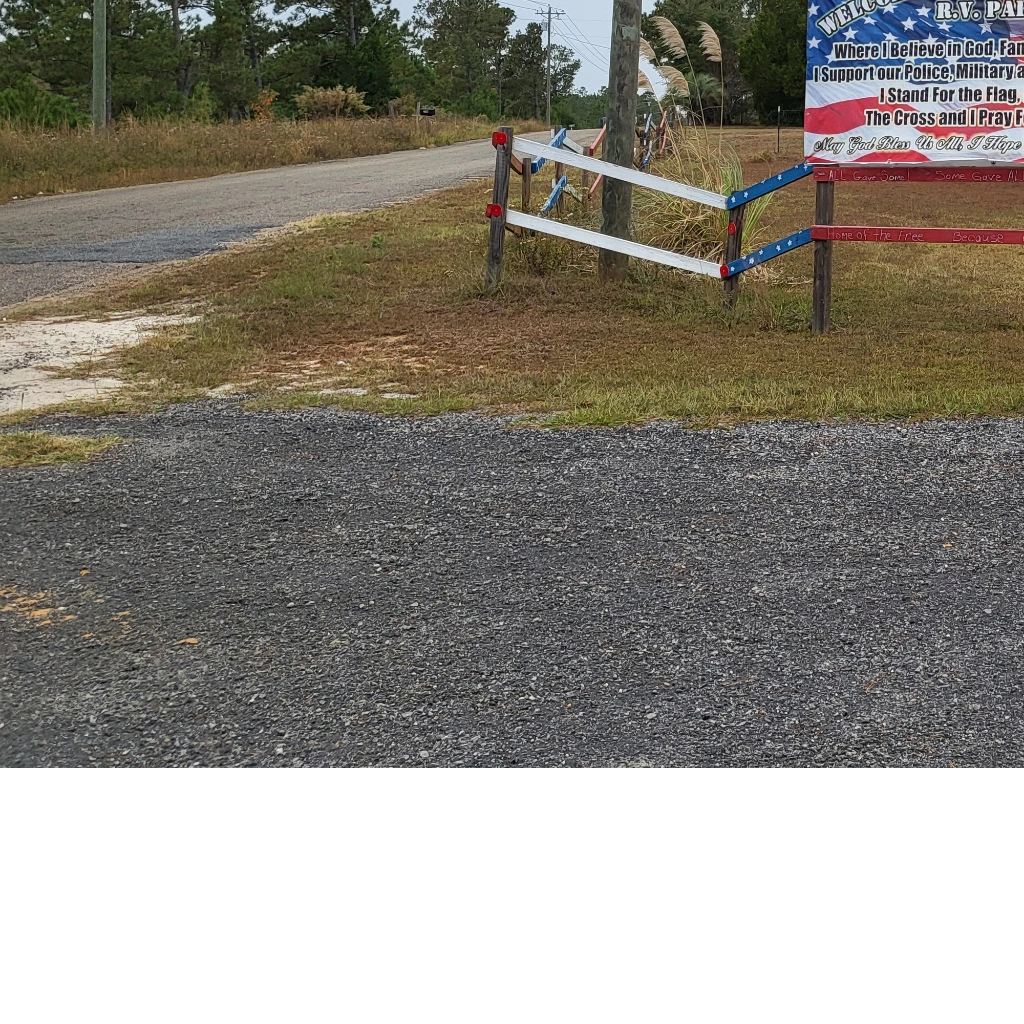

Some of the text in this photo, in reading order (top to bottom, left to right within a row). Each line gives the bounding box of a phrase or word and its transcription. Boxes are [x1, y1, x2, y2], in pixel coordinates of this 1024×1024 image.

[936, 0, 980, 20] R.V.
[834, 43, 879, 59] Where
[883, 42, 887, 58] I
[890, 41, 945, 58] Believe
[947, 41, 963, 56] in
[965, 40, 997, 57] God,
[814, 67, 818, 82] I
[821, 66, 875, 83] Support
[877, 66, 901, 81] our
[904, 64, 953, 82] Police,
[956, 63, 1014, 80] Military
[880, 87, 884, 103] I
[888, 87, 929, 103] Stand
[932, 87, 955, 102] For
[958, 86, 982, 102] the
[986, 86, 1020, 103] Flag,
[865, 110, 891, 126] The
[894, 109, 936, 125] Cross
[938, 109, 966, 125] and
[970, 110, 974, 125] I
[979, 109, 1013, 126] Pray
[814, 137, 845, 154] May
[847, 136, 876, 155] God
[876, 136, 910, 150] Bless
[915, 135, 933, 150] Us
[936, 136, 963, 151] All,
[967, 135, 983, 150] I
[982, 135, 1022, 153] Hope
